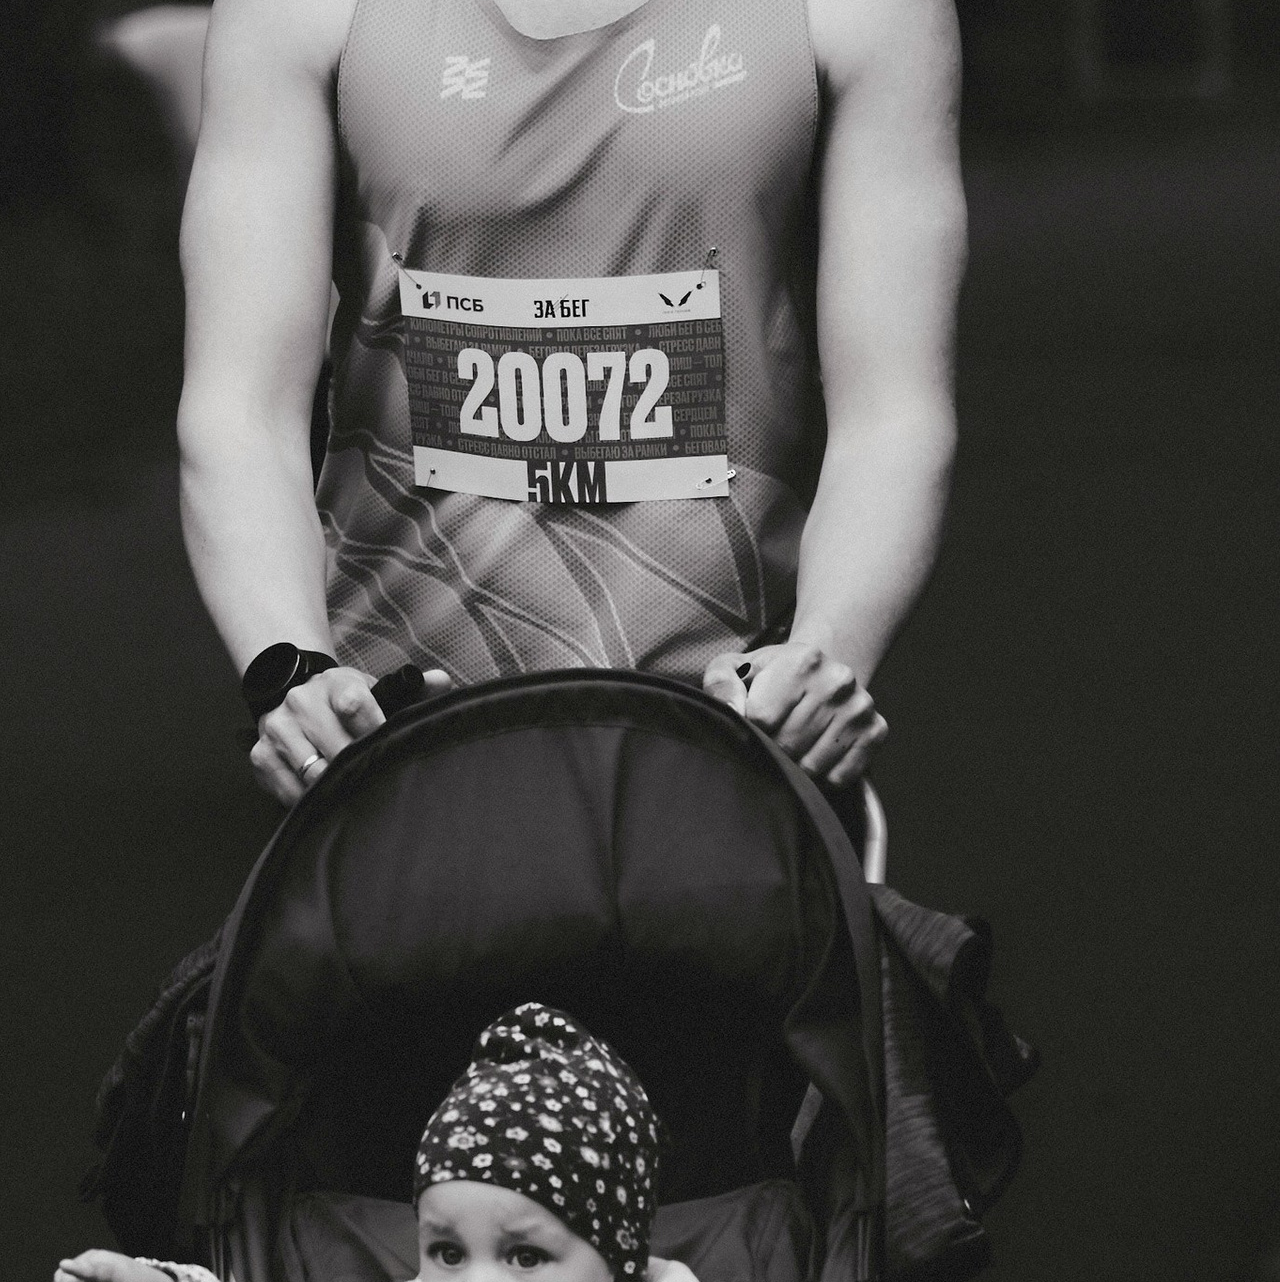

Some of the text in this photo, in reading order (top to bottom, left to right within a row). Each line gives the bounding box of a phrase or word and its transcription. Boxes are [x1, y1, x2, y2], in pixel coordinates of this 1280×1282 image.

[446, 295, 484, 313] ПСБ
[534, 299, 589, 319] ЗА БЕГ
[410, 317, 464, 337] КИЛОМЕТРЫ
[556, 328, 583, 342] ПОКА
[584, 327, 602, 341] ВСЕ
[603, 326, 627, 340] СПЯТ
[648, 323, 677, 338] ЛЮБИ
[678, 321, 694, 336] БЕГ
[696, 320, 703, 335] В
[659, 338, 695, 353] СТРЕСС
[684, 372, 708, 387] СПЯТ
[457, 348, 673, 442] 20072
[657, 388, 723, 406] ЕРЕЗАГРУЗКА
[674, 406, 718, 422] СЕРДЦЕМ
[690, 423, 715, 438] ПОКА
[458, 438, 490, 455] СТРЕСС
[491, 442, 521, 458] ДАВНО
[522, 445, 557, 460] ОТСТАЛ
[574, 445, 621, 460] ВЫБЕГАЮ
[622, 444, 634, 459] ЗА
[635, 443, 668, 458] РАМКИ
[685, 439, 727, 455] БЕГОВАЯ
